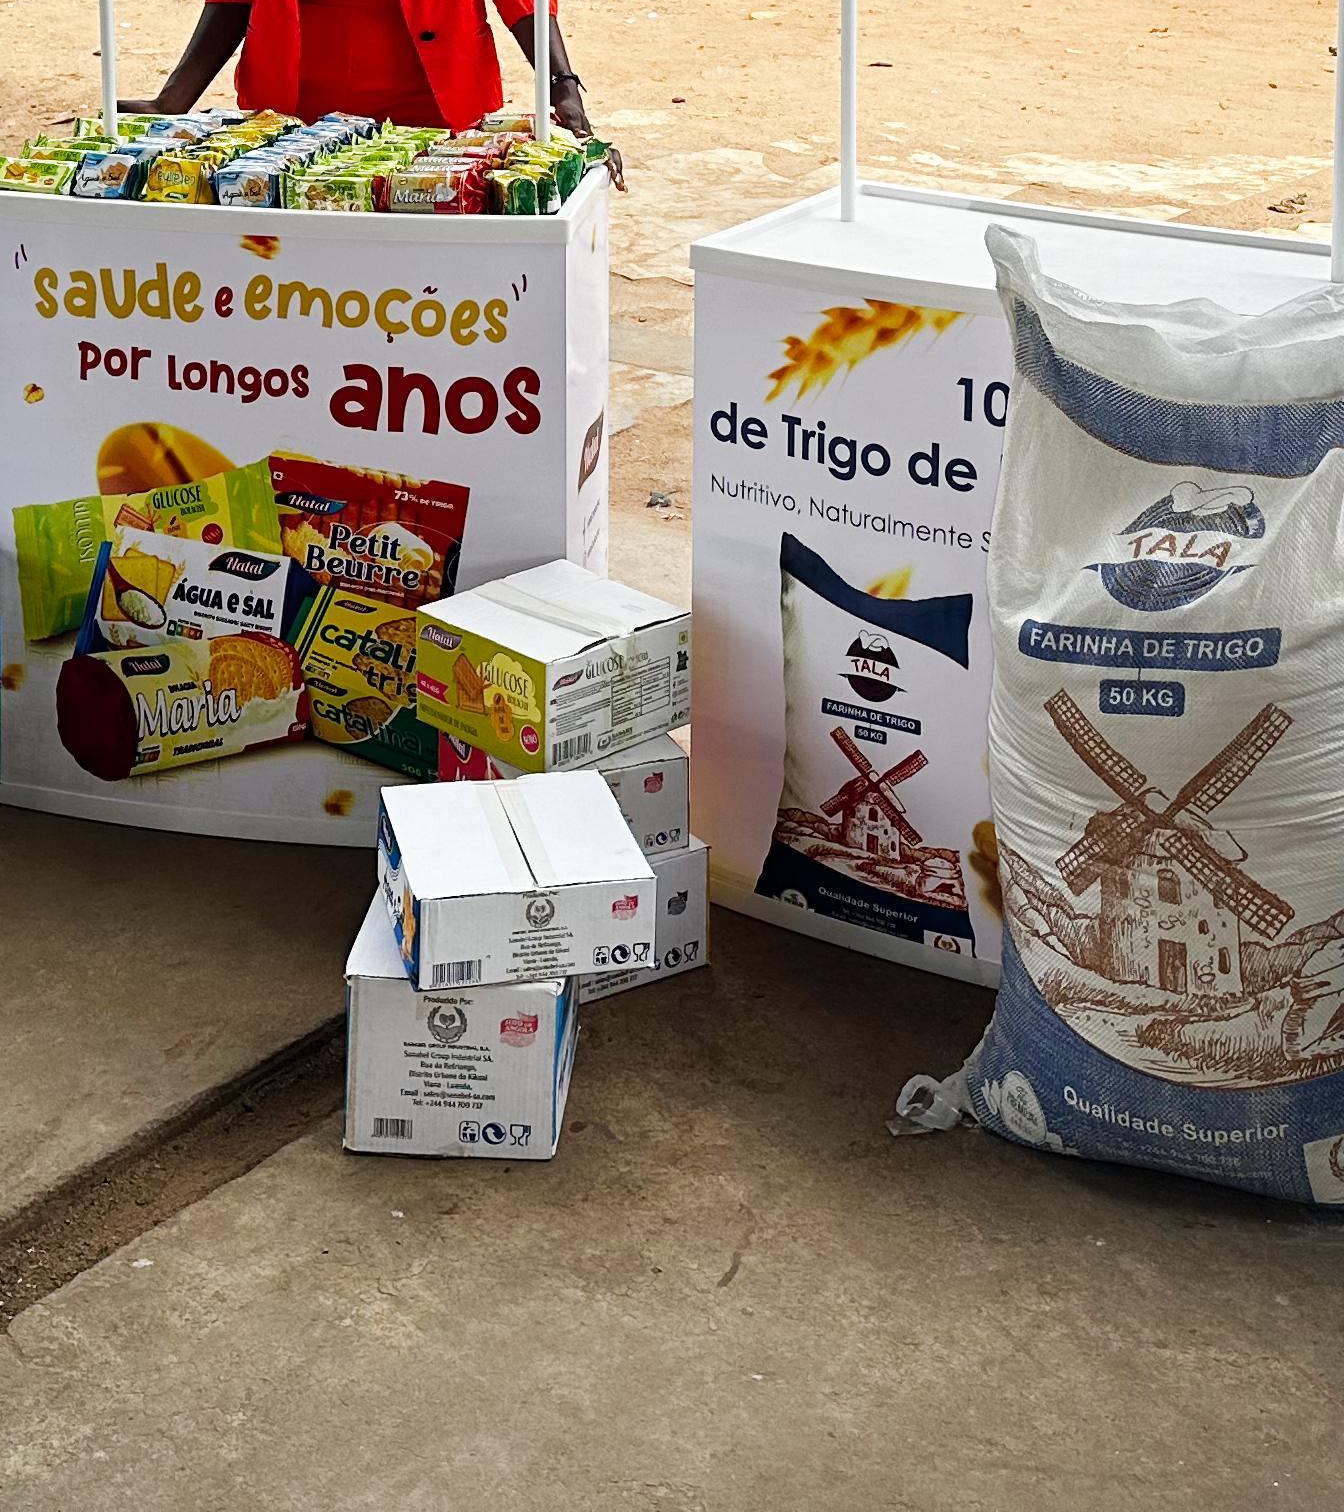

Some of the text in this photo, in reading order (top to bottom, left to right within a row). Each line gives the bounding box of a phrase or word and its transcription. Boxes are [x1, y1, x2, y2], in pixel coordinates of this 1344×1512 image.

[215, 286, 234, 318] e
[77, 340, 153, 381] por
[329, 363, 542, 436] anos
[710, 402, 978, 492] de Trigo de
[152, 485, 202, 509] GLUCOSE
[288, 493, 331, 512] Natal
[710, 473, 972, 550] Nutritivo, Naturalmente
[329, 523, 402, 561] Petit
[1127, 531, 1235, 569] TALA
[226, 555, 266, 576] Natal
[305, 543, 421, 588] Beurre
[173, 578, 274, 620] ÁGUA SAL
[1028, 626, 1266, 660] FARINHA DE TRIGO
[129, 656, 162, 675] Natal
[483, 663, 529, 696] GLUCOSE
[851, 657, 890, 682] TALA
[137, 679, 241, 740] Maria
[1108, 685, 1176, 709] 50 KG
[826, 701, 916, 730] FARINHA TRIGO
[818, 887, 869, 909] Qualidade
[873, 903, 918, 923] Superior
[1064, 1086, 1174, 1139] Qualidade
[1182, 1122, 1290, 1146] Superior
